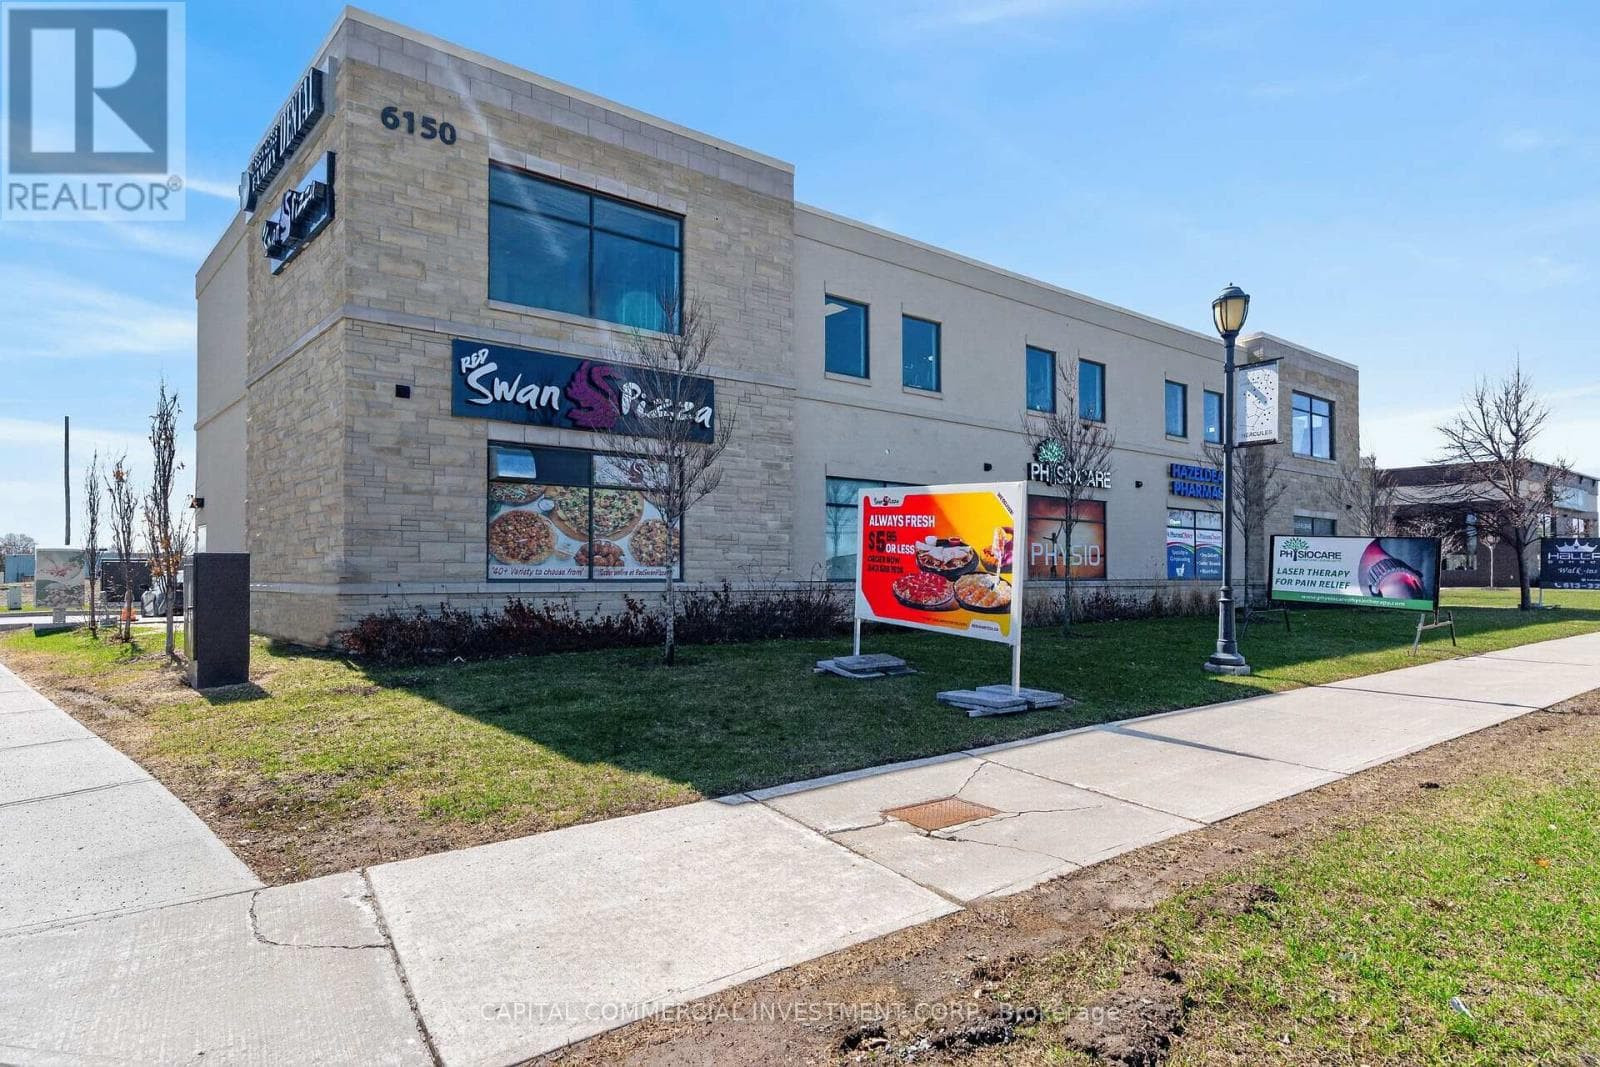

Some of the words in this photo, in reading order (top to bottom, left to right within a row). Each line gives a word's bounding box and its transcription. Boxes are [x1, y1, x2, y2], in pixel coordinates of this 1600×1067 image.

[279, 67, 315, 158] DENTAL
[381, 106, 457, 145] 6150
[461, 348, 489, 373] RED
[467, 362, 560, 411] Swan
[621, 382, 713, 428] Pizza
[1171, 463, 1224, 483] HAZELDEA
[869, 514, 904, 527] ALWAYS
[905, 515, 936, 528] FRESH
[885, 543, 896, 553] OR
[897, 544, 915, 554] LESS
[1279, 549, 1342, 561] PHYSIOCARE
[535, 567, 543, 576] to
[543, 567, 566, 576] choose
[1276, 567, 1305, 576] LASER
[1307, 568, 1351, 578] THERAPY
[1274, 578, 1293, 586] FOR
[1295, 579, 1317, 588] PAIN
[1319, 581, 1351, 590] RELIEF
